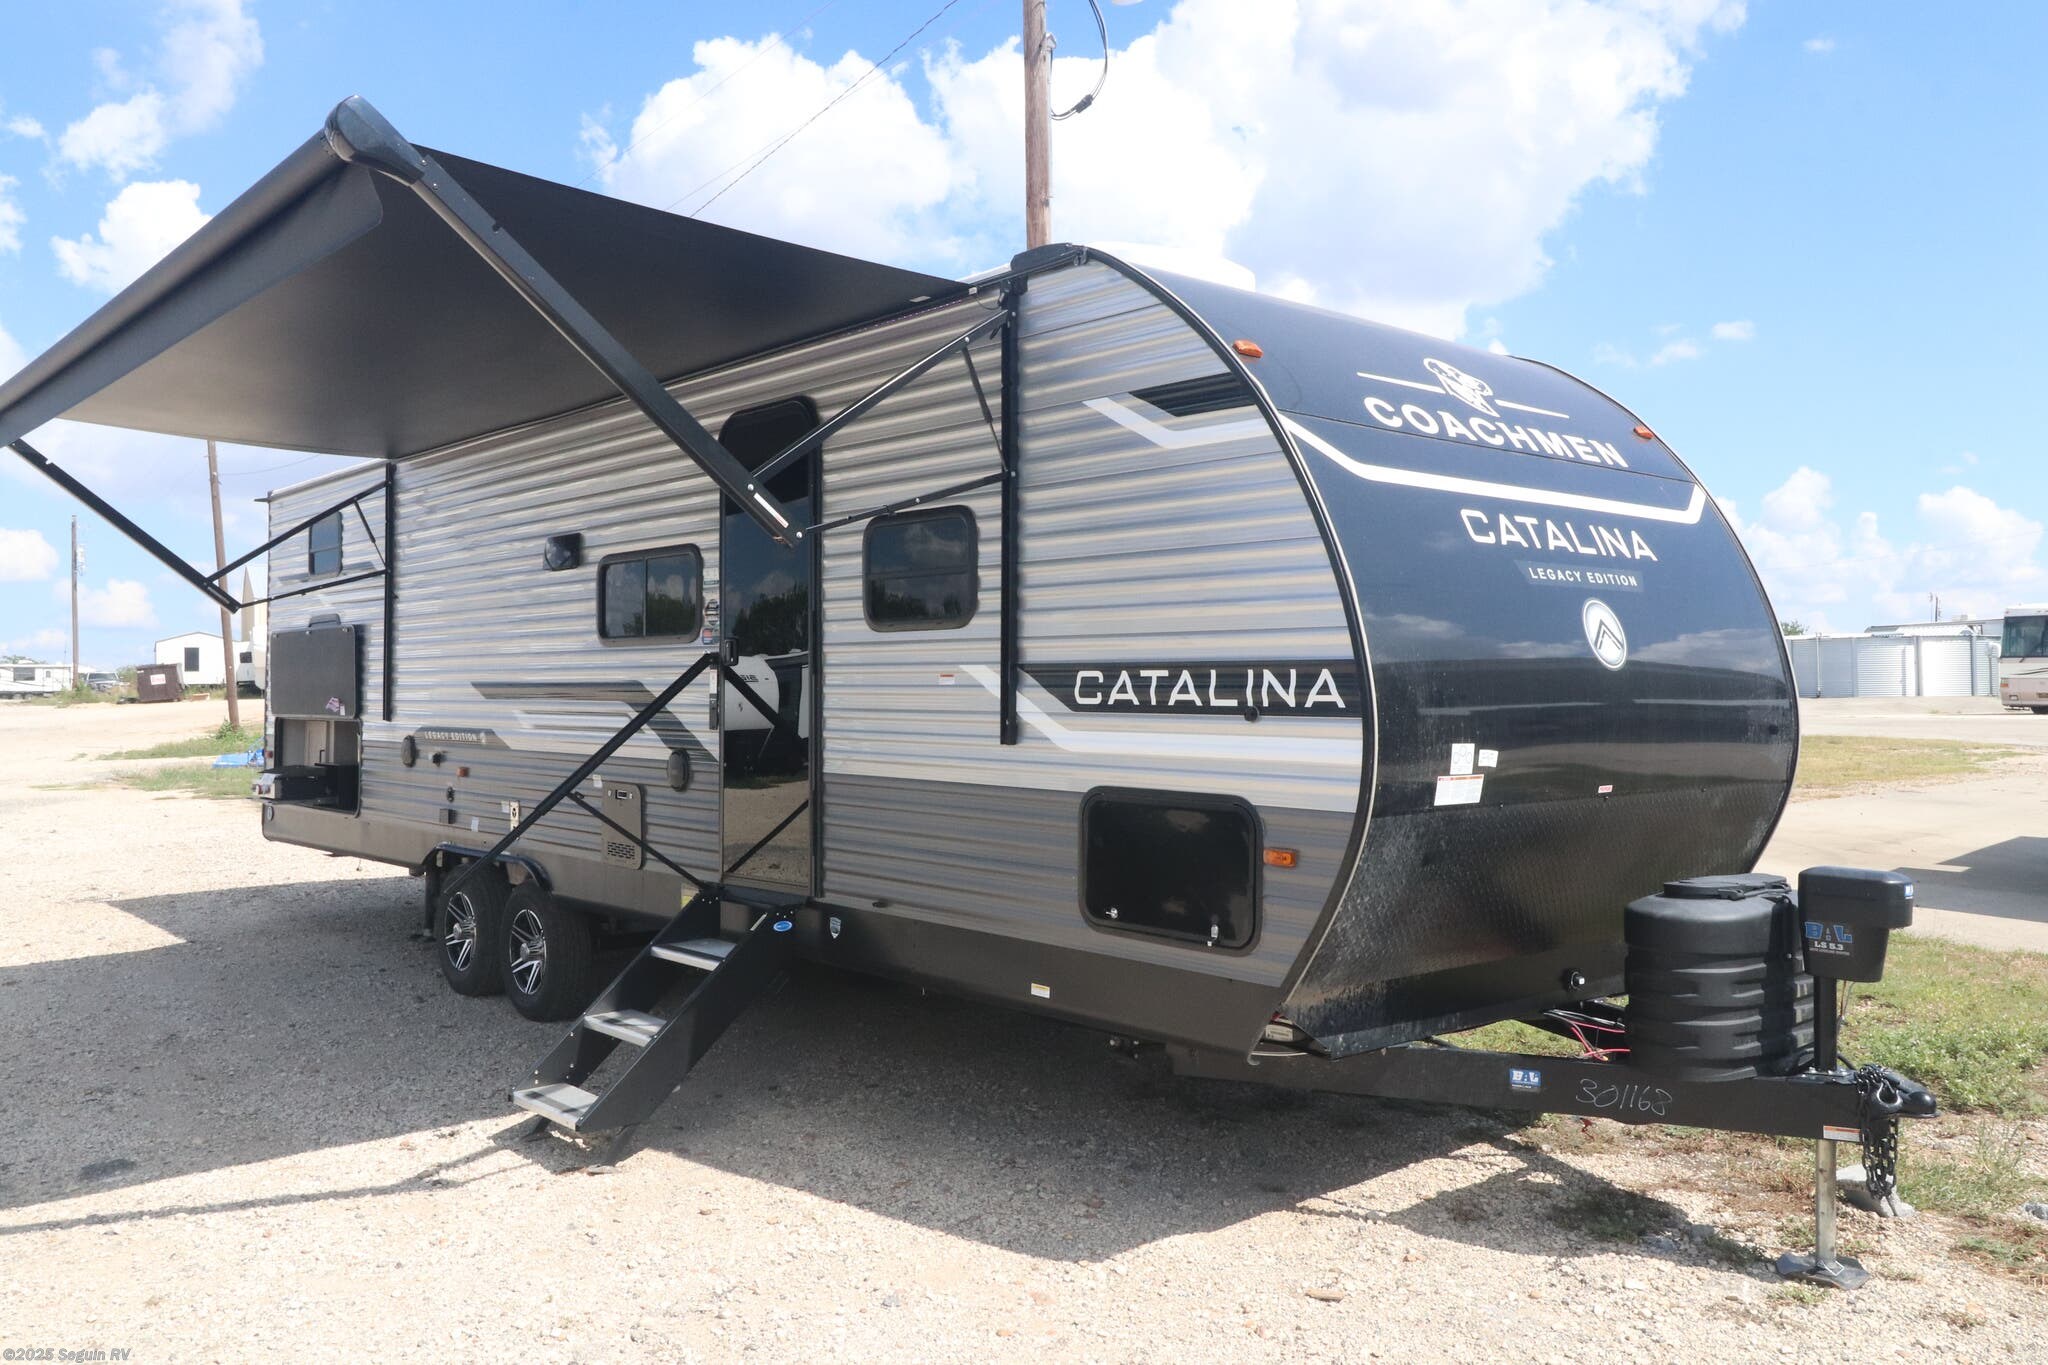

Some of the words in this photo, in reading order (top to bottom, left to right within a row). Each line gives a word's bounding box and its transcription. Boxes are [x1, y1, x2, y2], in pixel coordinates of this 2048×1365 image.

[1364, 397, 1629, 467] COACHMEN
[1460, 508, 1658, 561] CATALINA
[1528, 567, 1581, 582] LEGACY
[1587, 572, 1638, 587] EDITION
[1074, 668, 1346, 709] CATALINA
